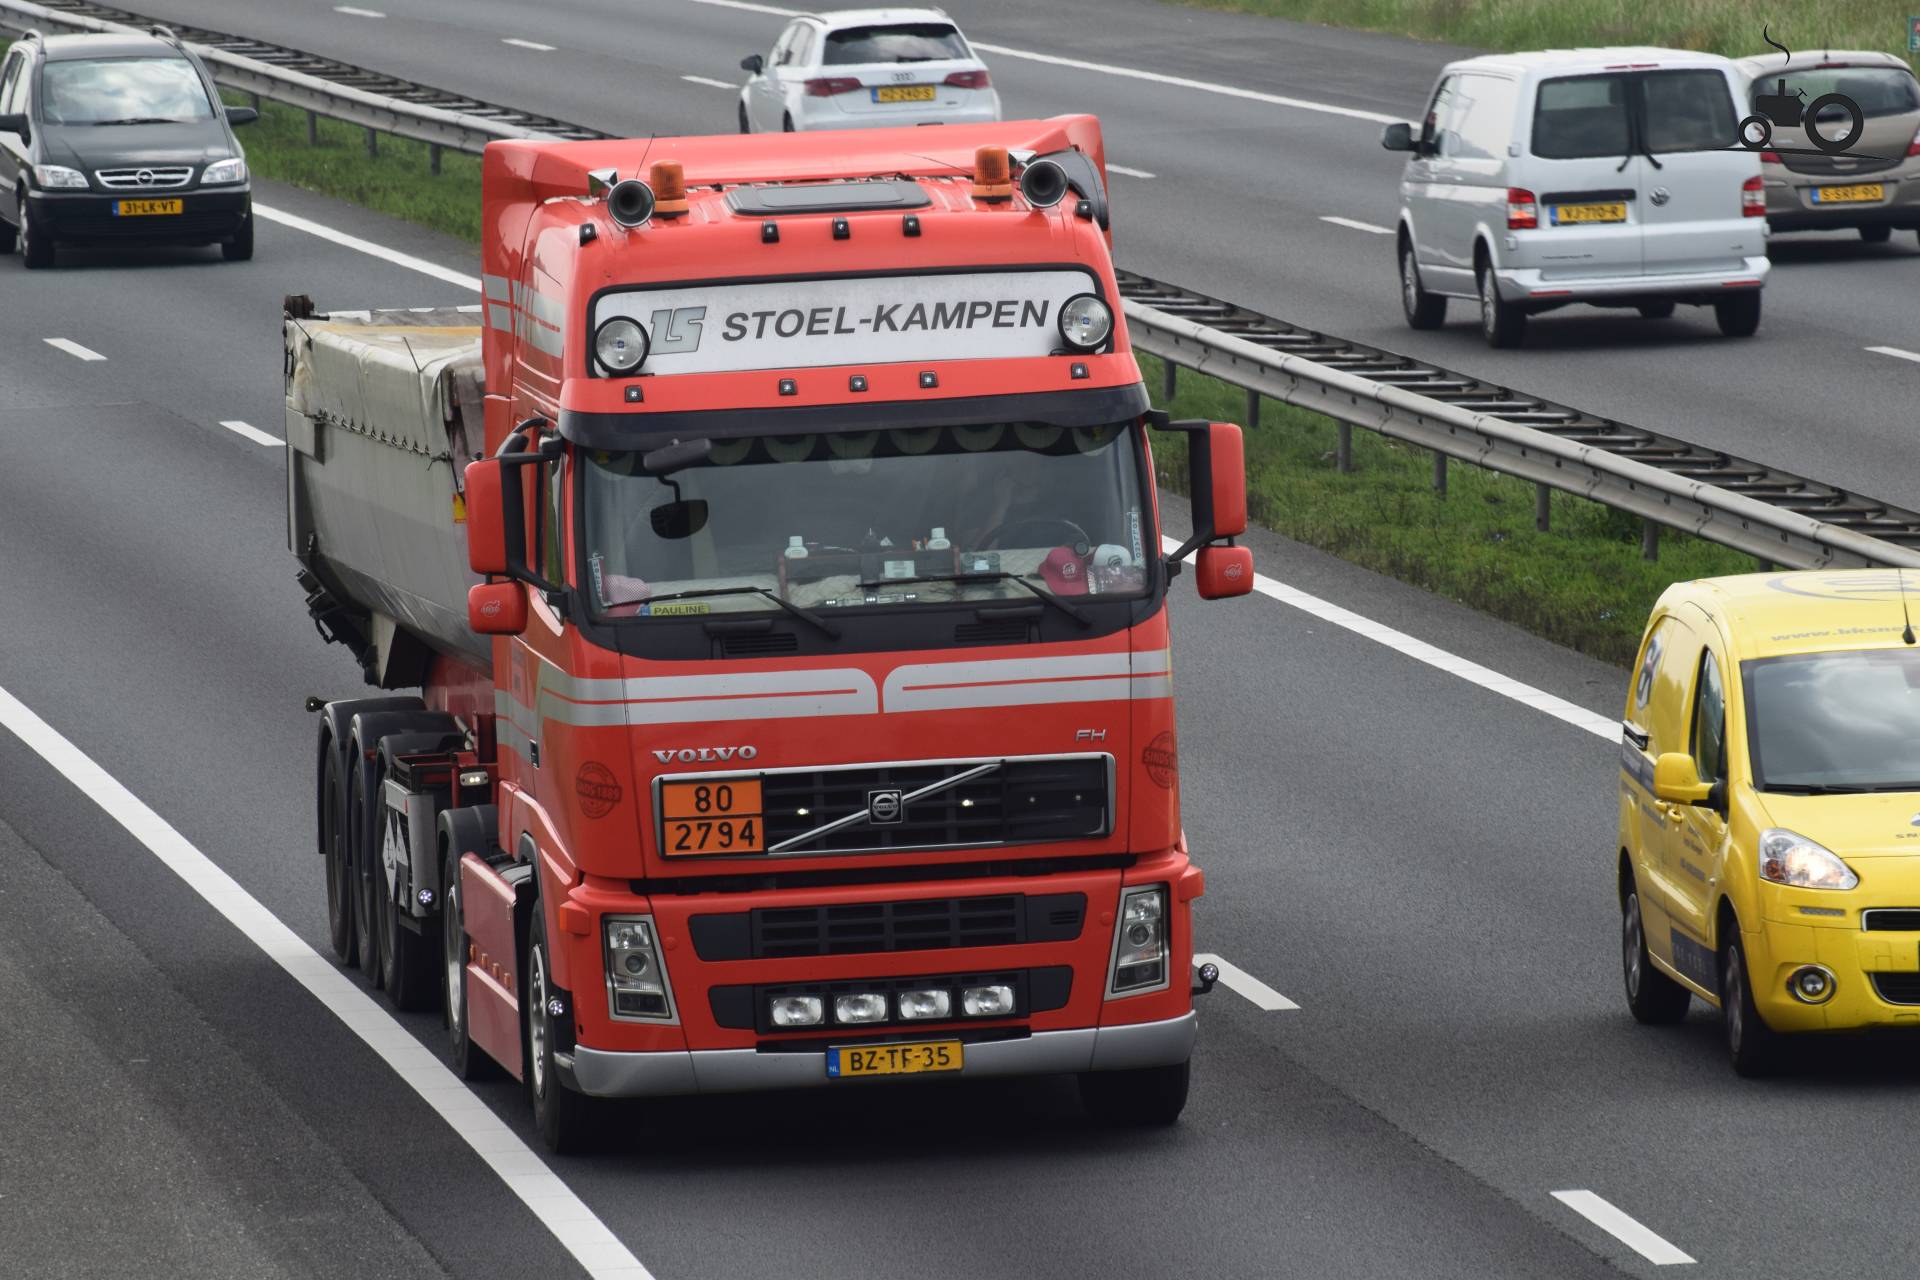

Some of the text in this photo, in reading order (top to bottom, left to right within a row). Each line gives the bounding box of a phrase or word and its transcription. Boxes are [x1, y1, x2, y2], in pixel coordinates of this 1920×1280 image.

[125, 201, 176, 213] 31-LK-VT
[721, 300, 1050, 342] STOEL-KAMPEN
[654, 604, 705, 616] PAULINE
[1075, 729, 1106, 741] FH
[652, 745, 758, 764] VOLVO
[694, 784, 733, 813] 80
[674, 819, 756, 851] 2794
[850, 1046, 950, 1071] BZ-TF-35
